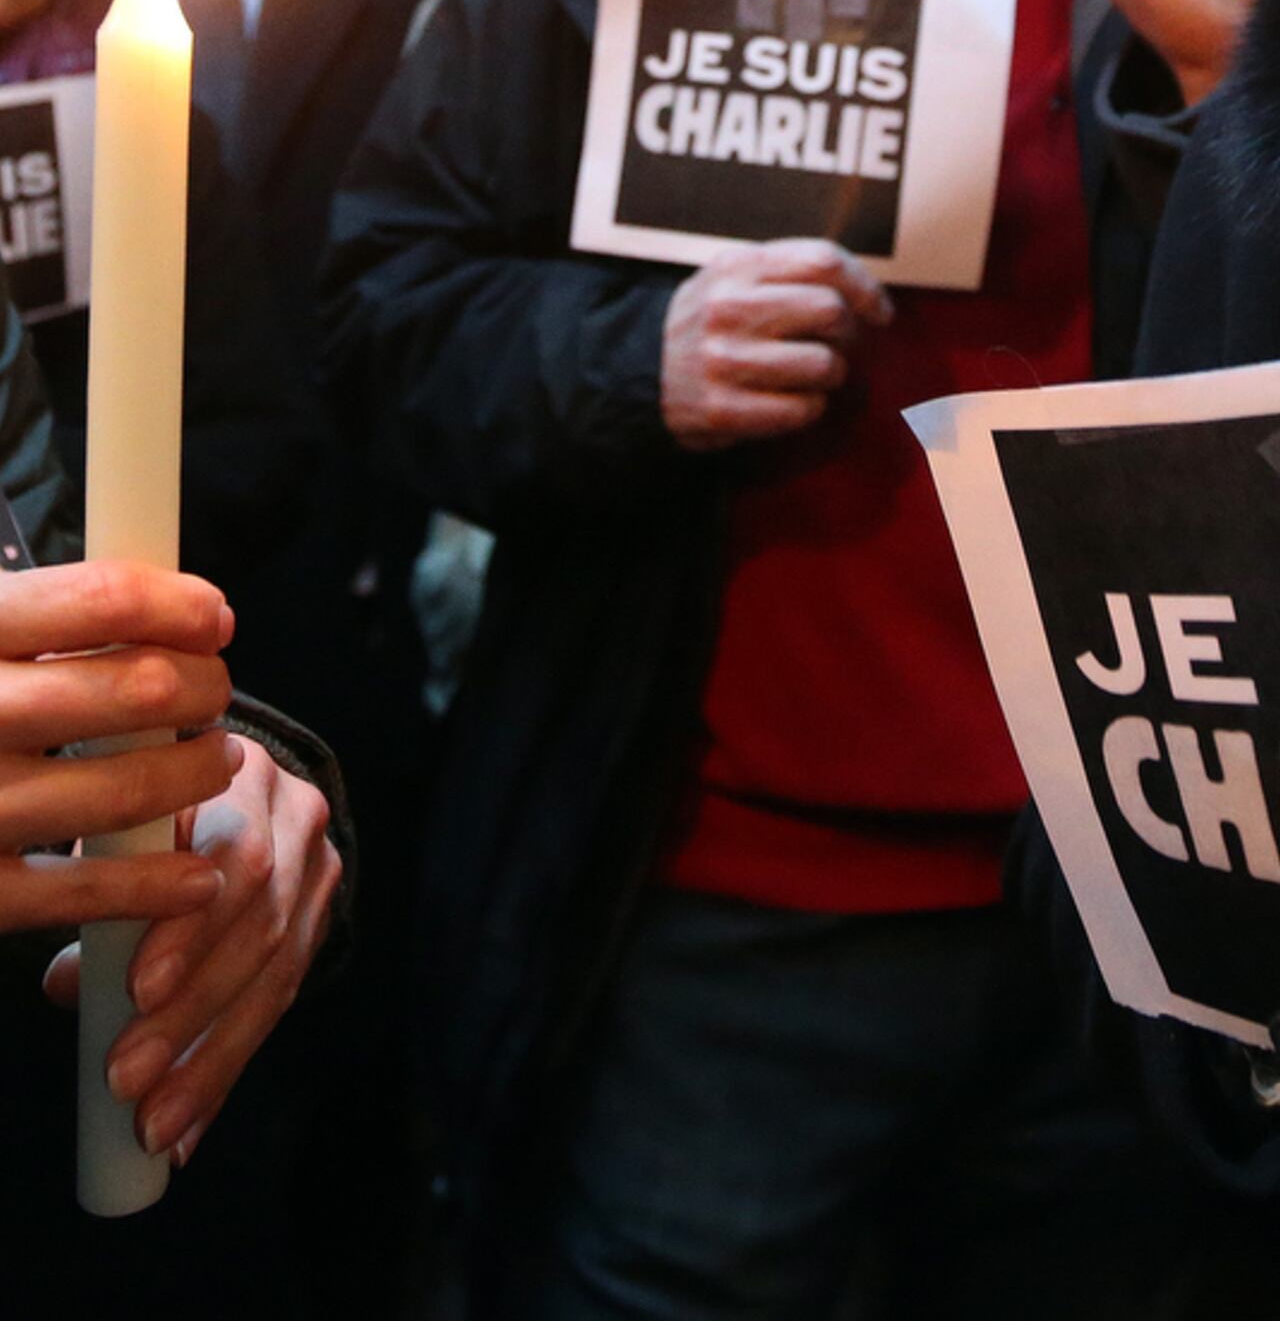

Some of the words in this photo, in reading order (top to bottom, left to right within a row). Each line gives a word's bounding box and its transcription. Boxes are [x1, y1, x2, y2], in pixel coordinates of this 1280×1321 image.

[643, 28, 734, 85] JE
[741, 35, 908, 103] SUIS
[634, 83, 904, 180] CHARLIE
[1075, 591, 1259, 706] JE
